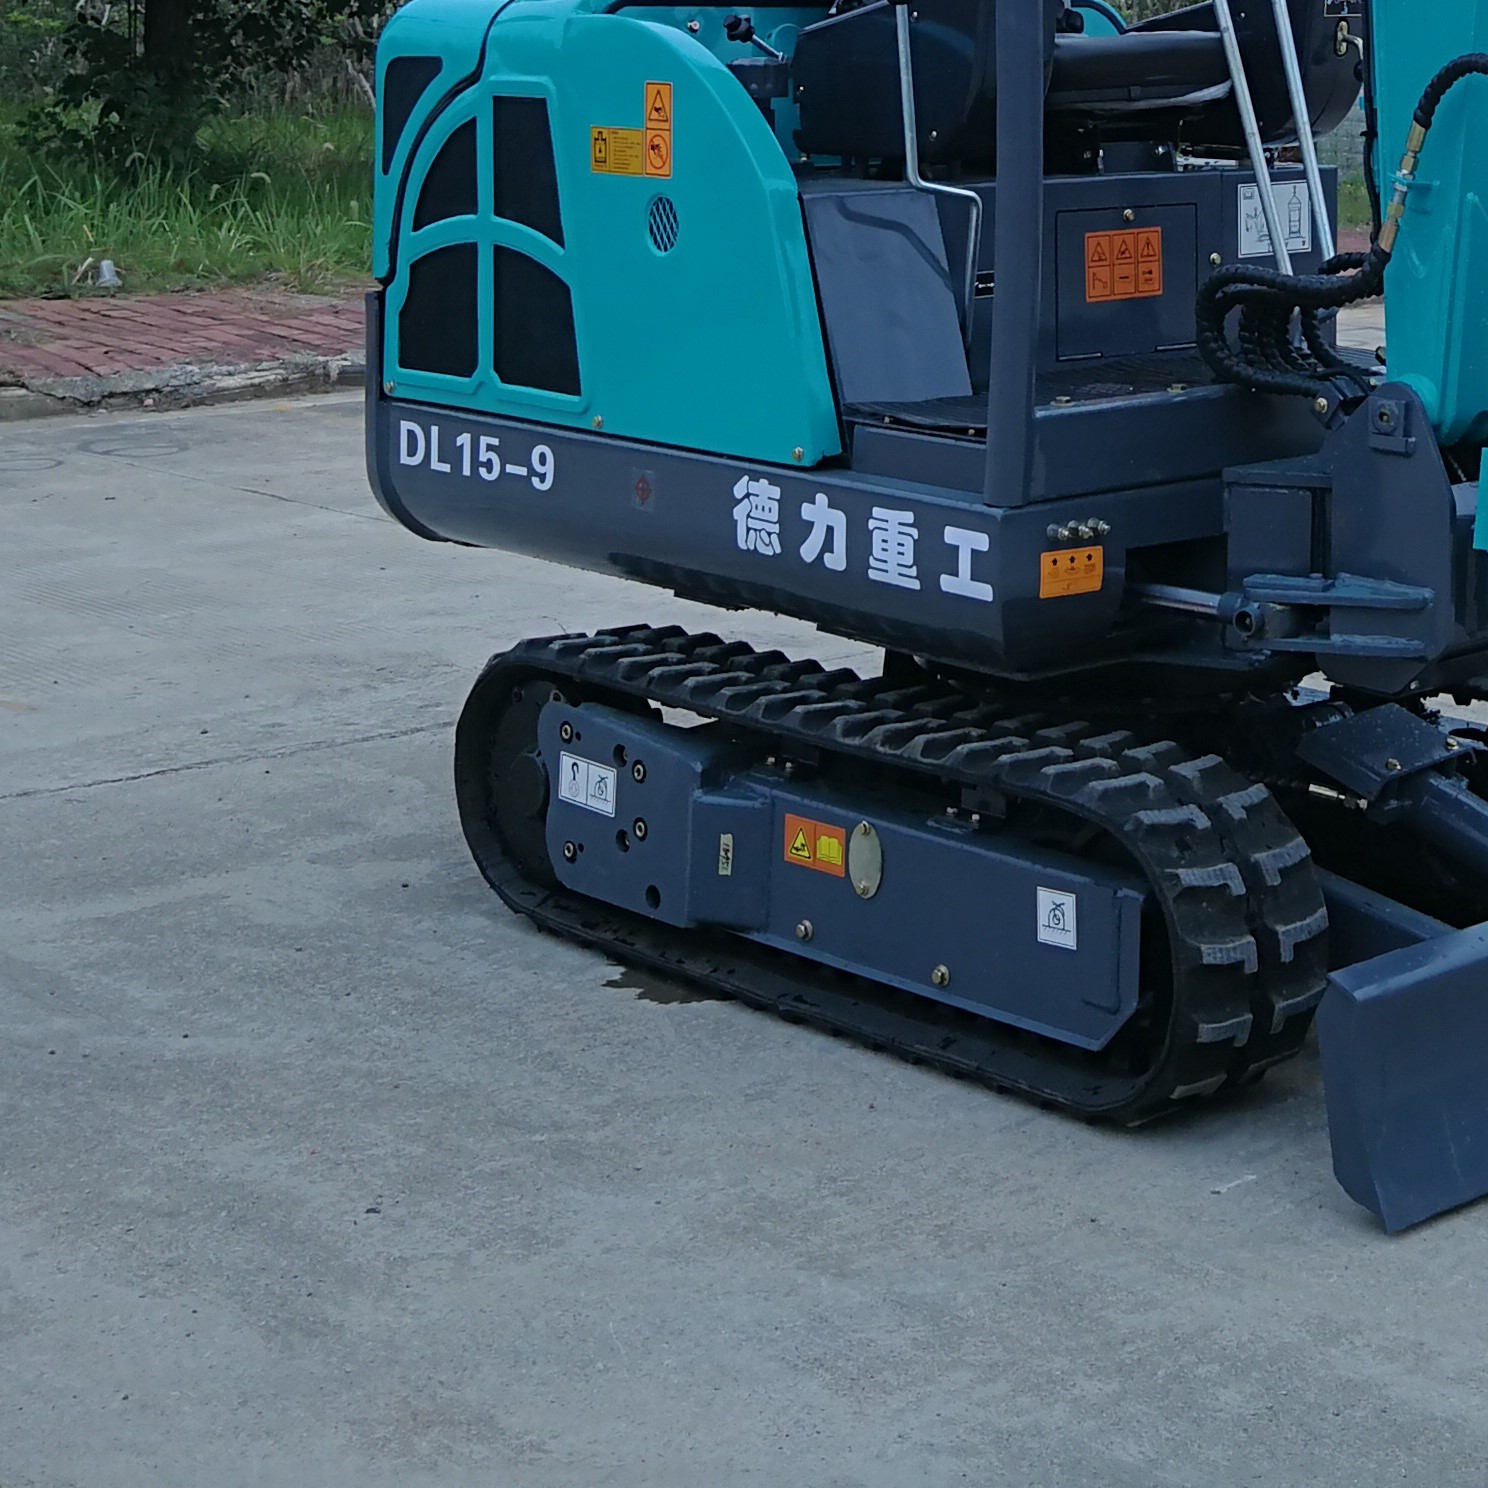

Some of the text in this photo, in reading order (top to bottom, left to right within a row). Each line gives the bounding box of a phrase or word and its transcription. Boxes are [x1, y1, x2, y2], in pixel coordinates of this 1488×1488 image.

[399, 419, 555, 491] DL15-9
[732, 475, 994, 603] 德力重工
